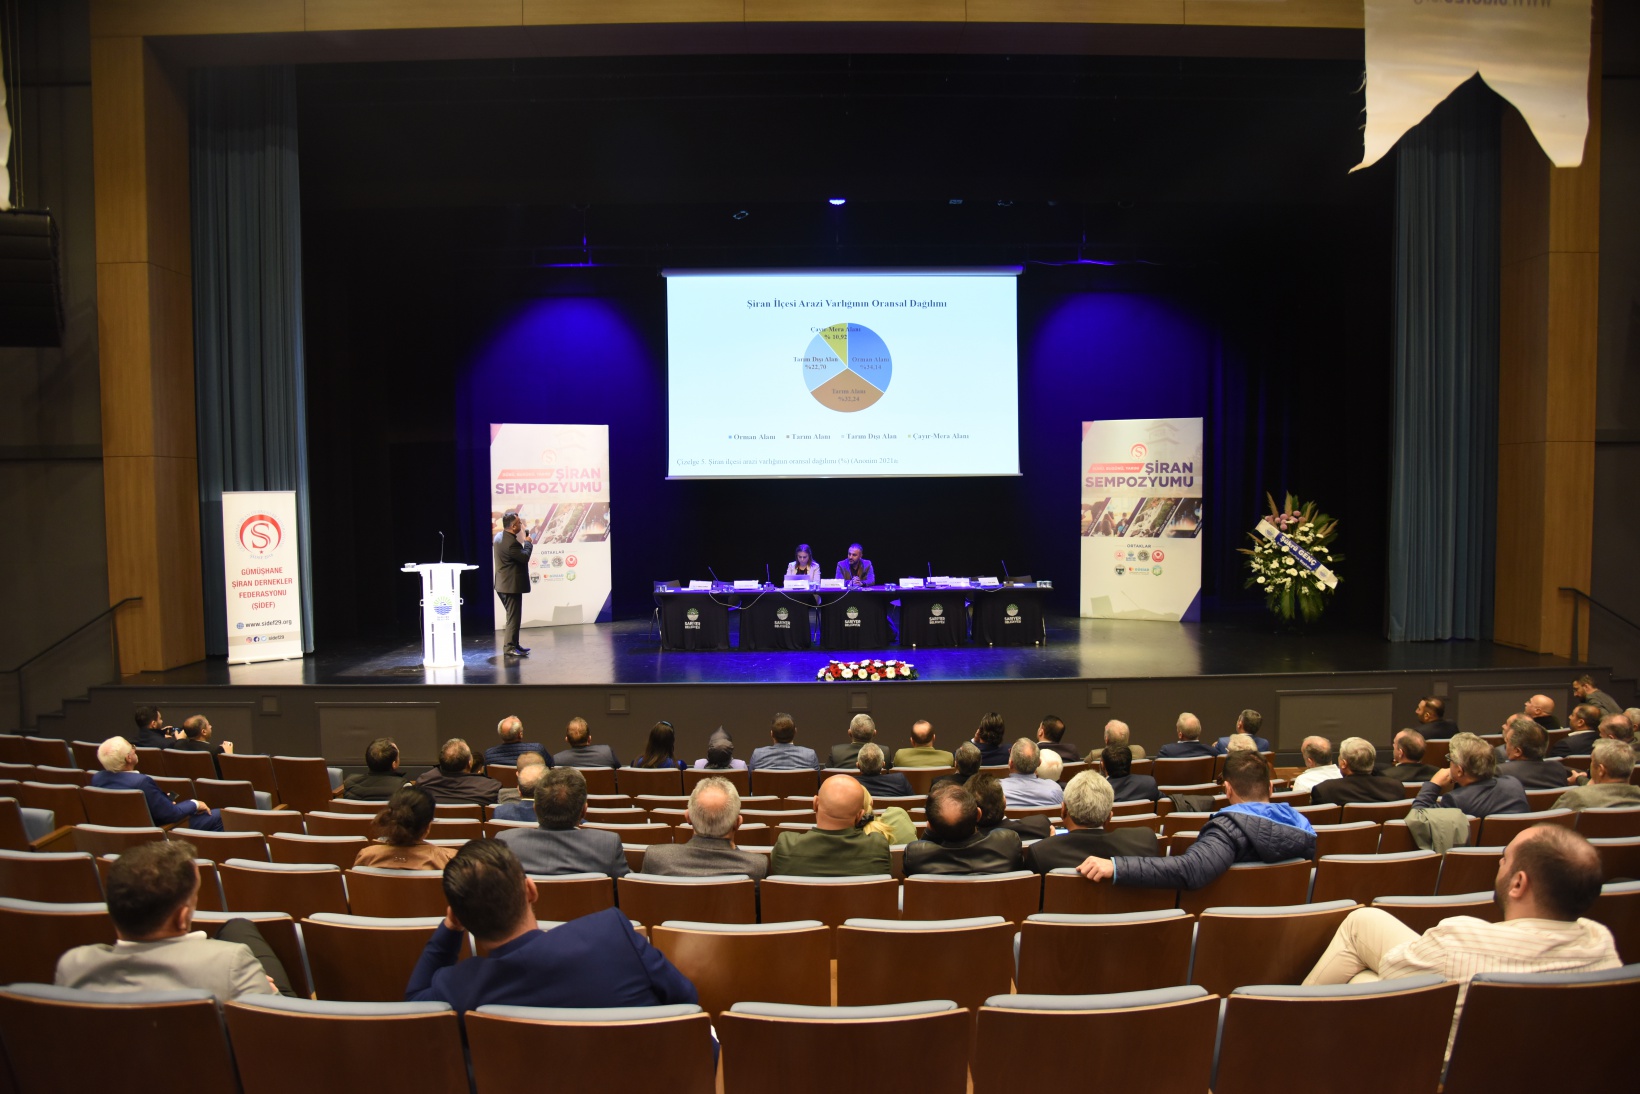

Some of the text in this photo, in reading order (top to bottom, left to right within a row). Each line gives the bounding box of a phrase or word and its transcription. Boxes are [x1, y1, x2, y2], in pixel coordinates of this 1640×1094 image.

[746, 298, 947, 309] Şiran İlçesi Arazi Varlığının Oransal Dağılımı
[1145, 460, 1193, 475] ŞİRAN
[556, 466, 600, 481] ŞİRAN
[1085, 476, 1193, 487] SEMPOZYUMU
[496, 482, 602, 494] SEMPOZYUMU
[241, 567, 283, 576] GÜMÜŞHANE
[232, 578, 292, 589] ŞİRAN DERNEKLER
[239, 590, 286, 598] FEDERASYONU
[252, 601, 276, 610] (ŞİDEF)
